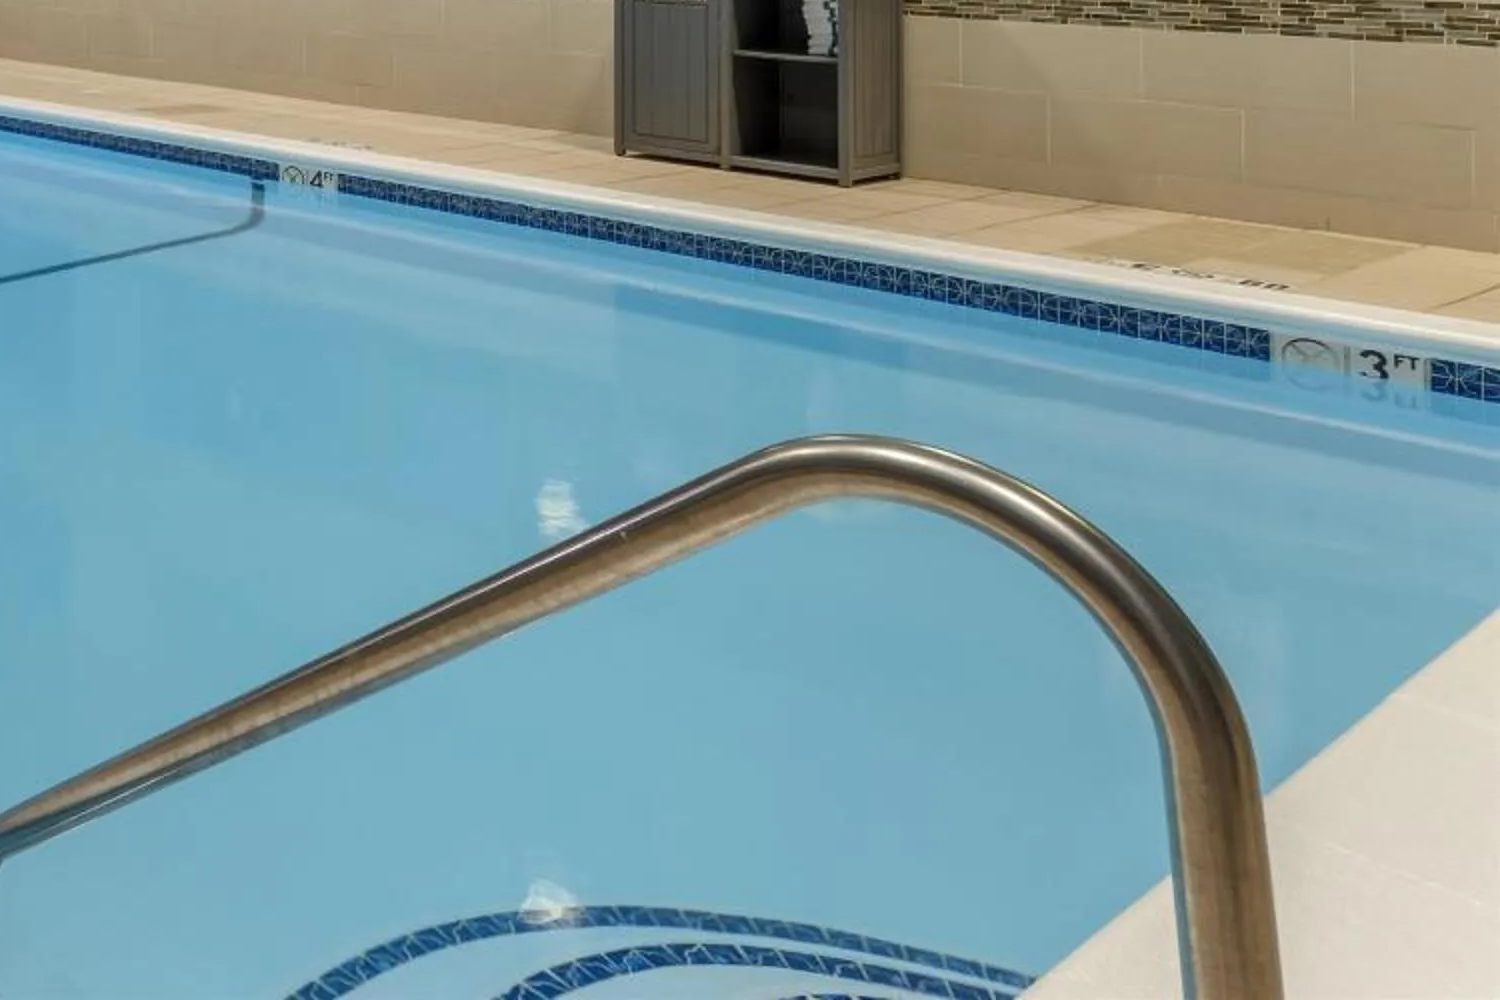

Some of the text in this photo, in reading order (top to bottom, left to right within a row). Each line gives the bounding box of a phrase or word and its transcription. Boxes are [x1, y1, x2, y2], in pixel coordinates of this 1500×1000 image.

[309, 170, 324, 189] 4
[1359, 349, 1421, 380] 3 FT
